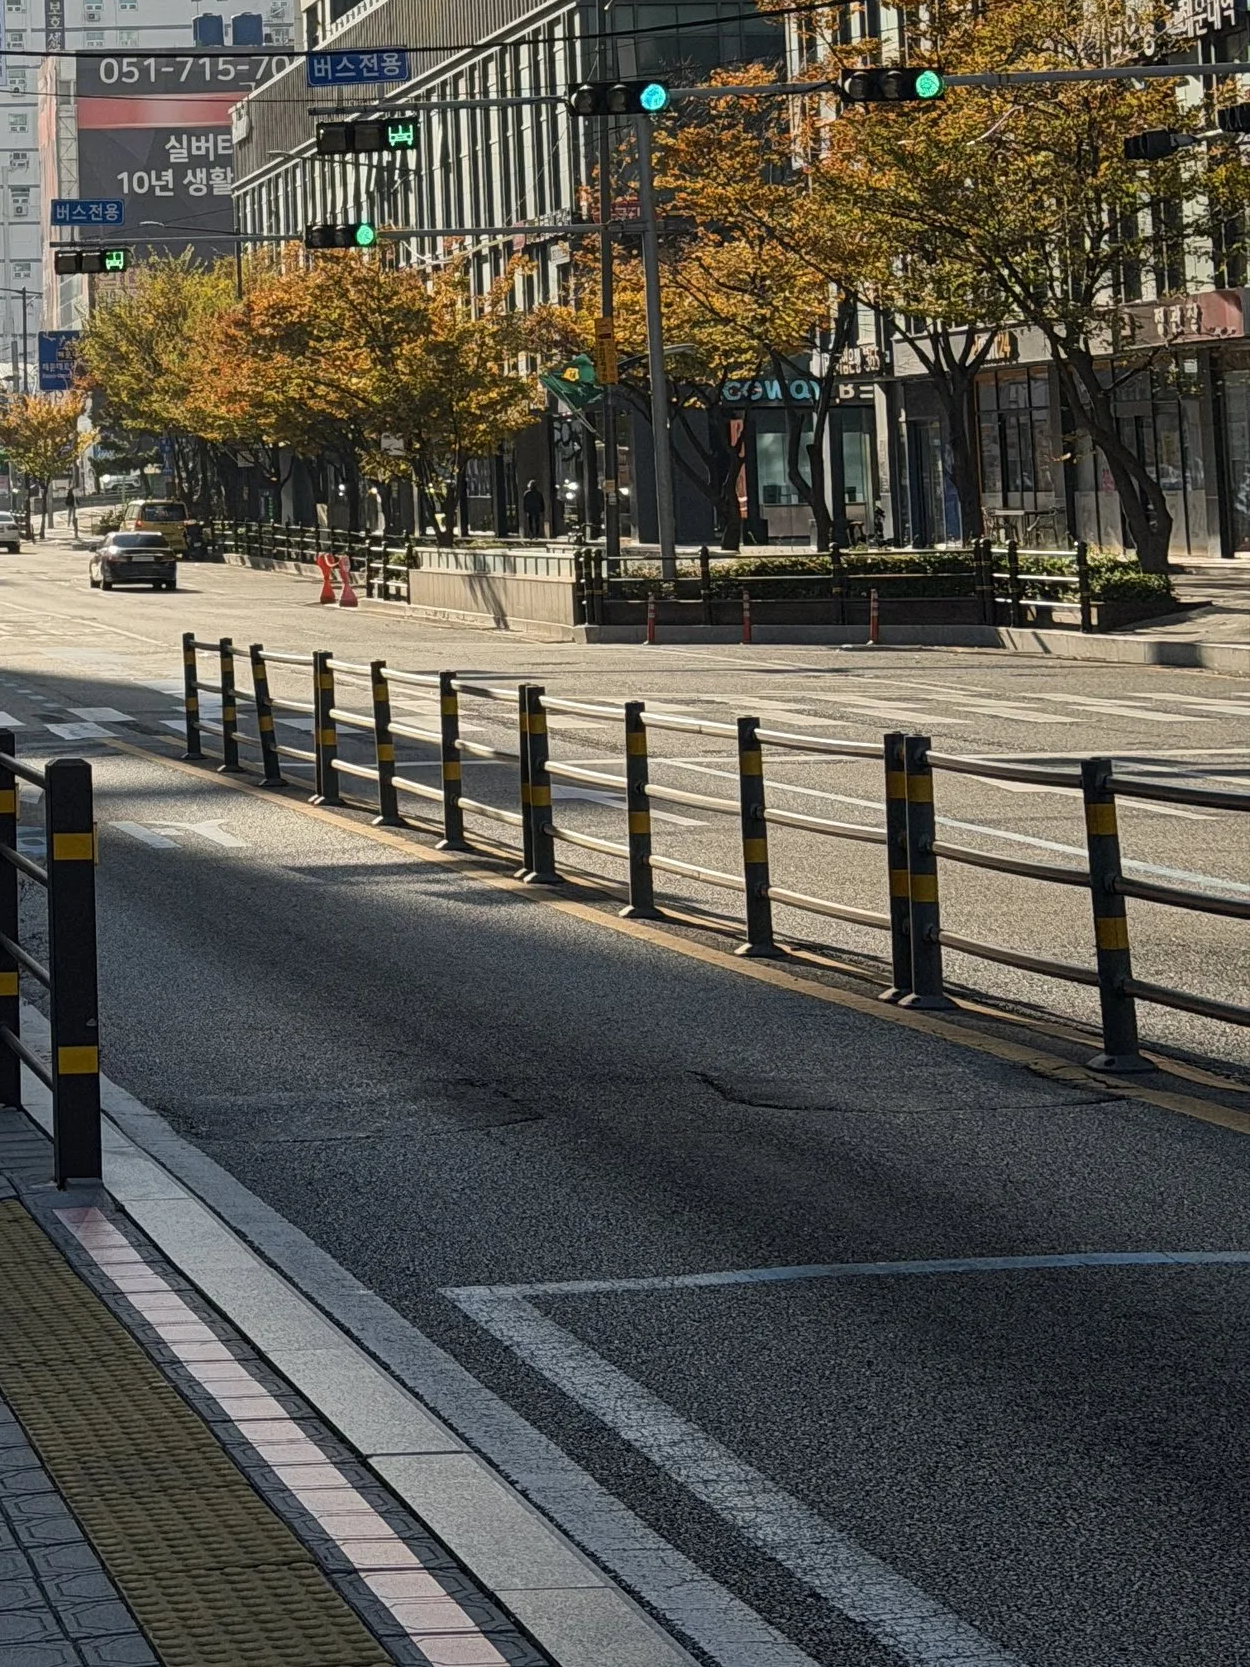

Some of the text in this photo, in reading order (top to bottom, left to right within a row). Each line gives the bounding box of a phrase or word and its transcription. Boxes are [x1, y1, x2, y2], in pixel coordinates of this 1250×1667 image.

[100, 55, 303, 84] 051-715-70
[313, 53, 402, 80] 버스전용
[116, 169, 174, 197] 10년
[56, 203, 119, 221] 버스전용
